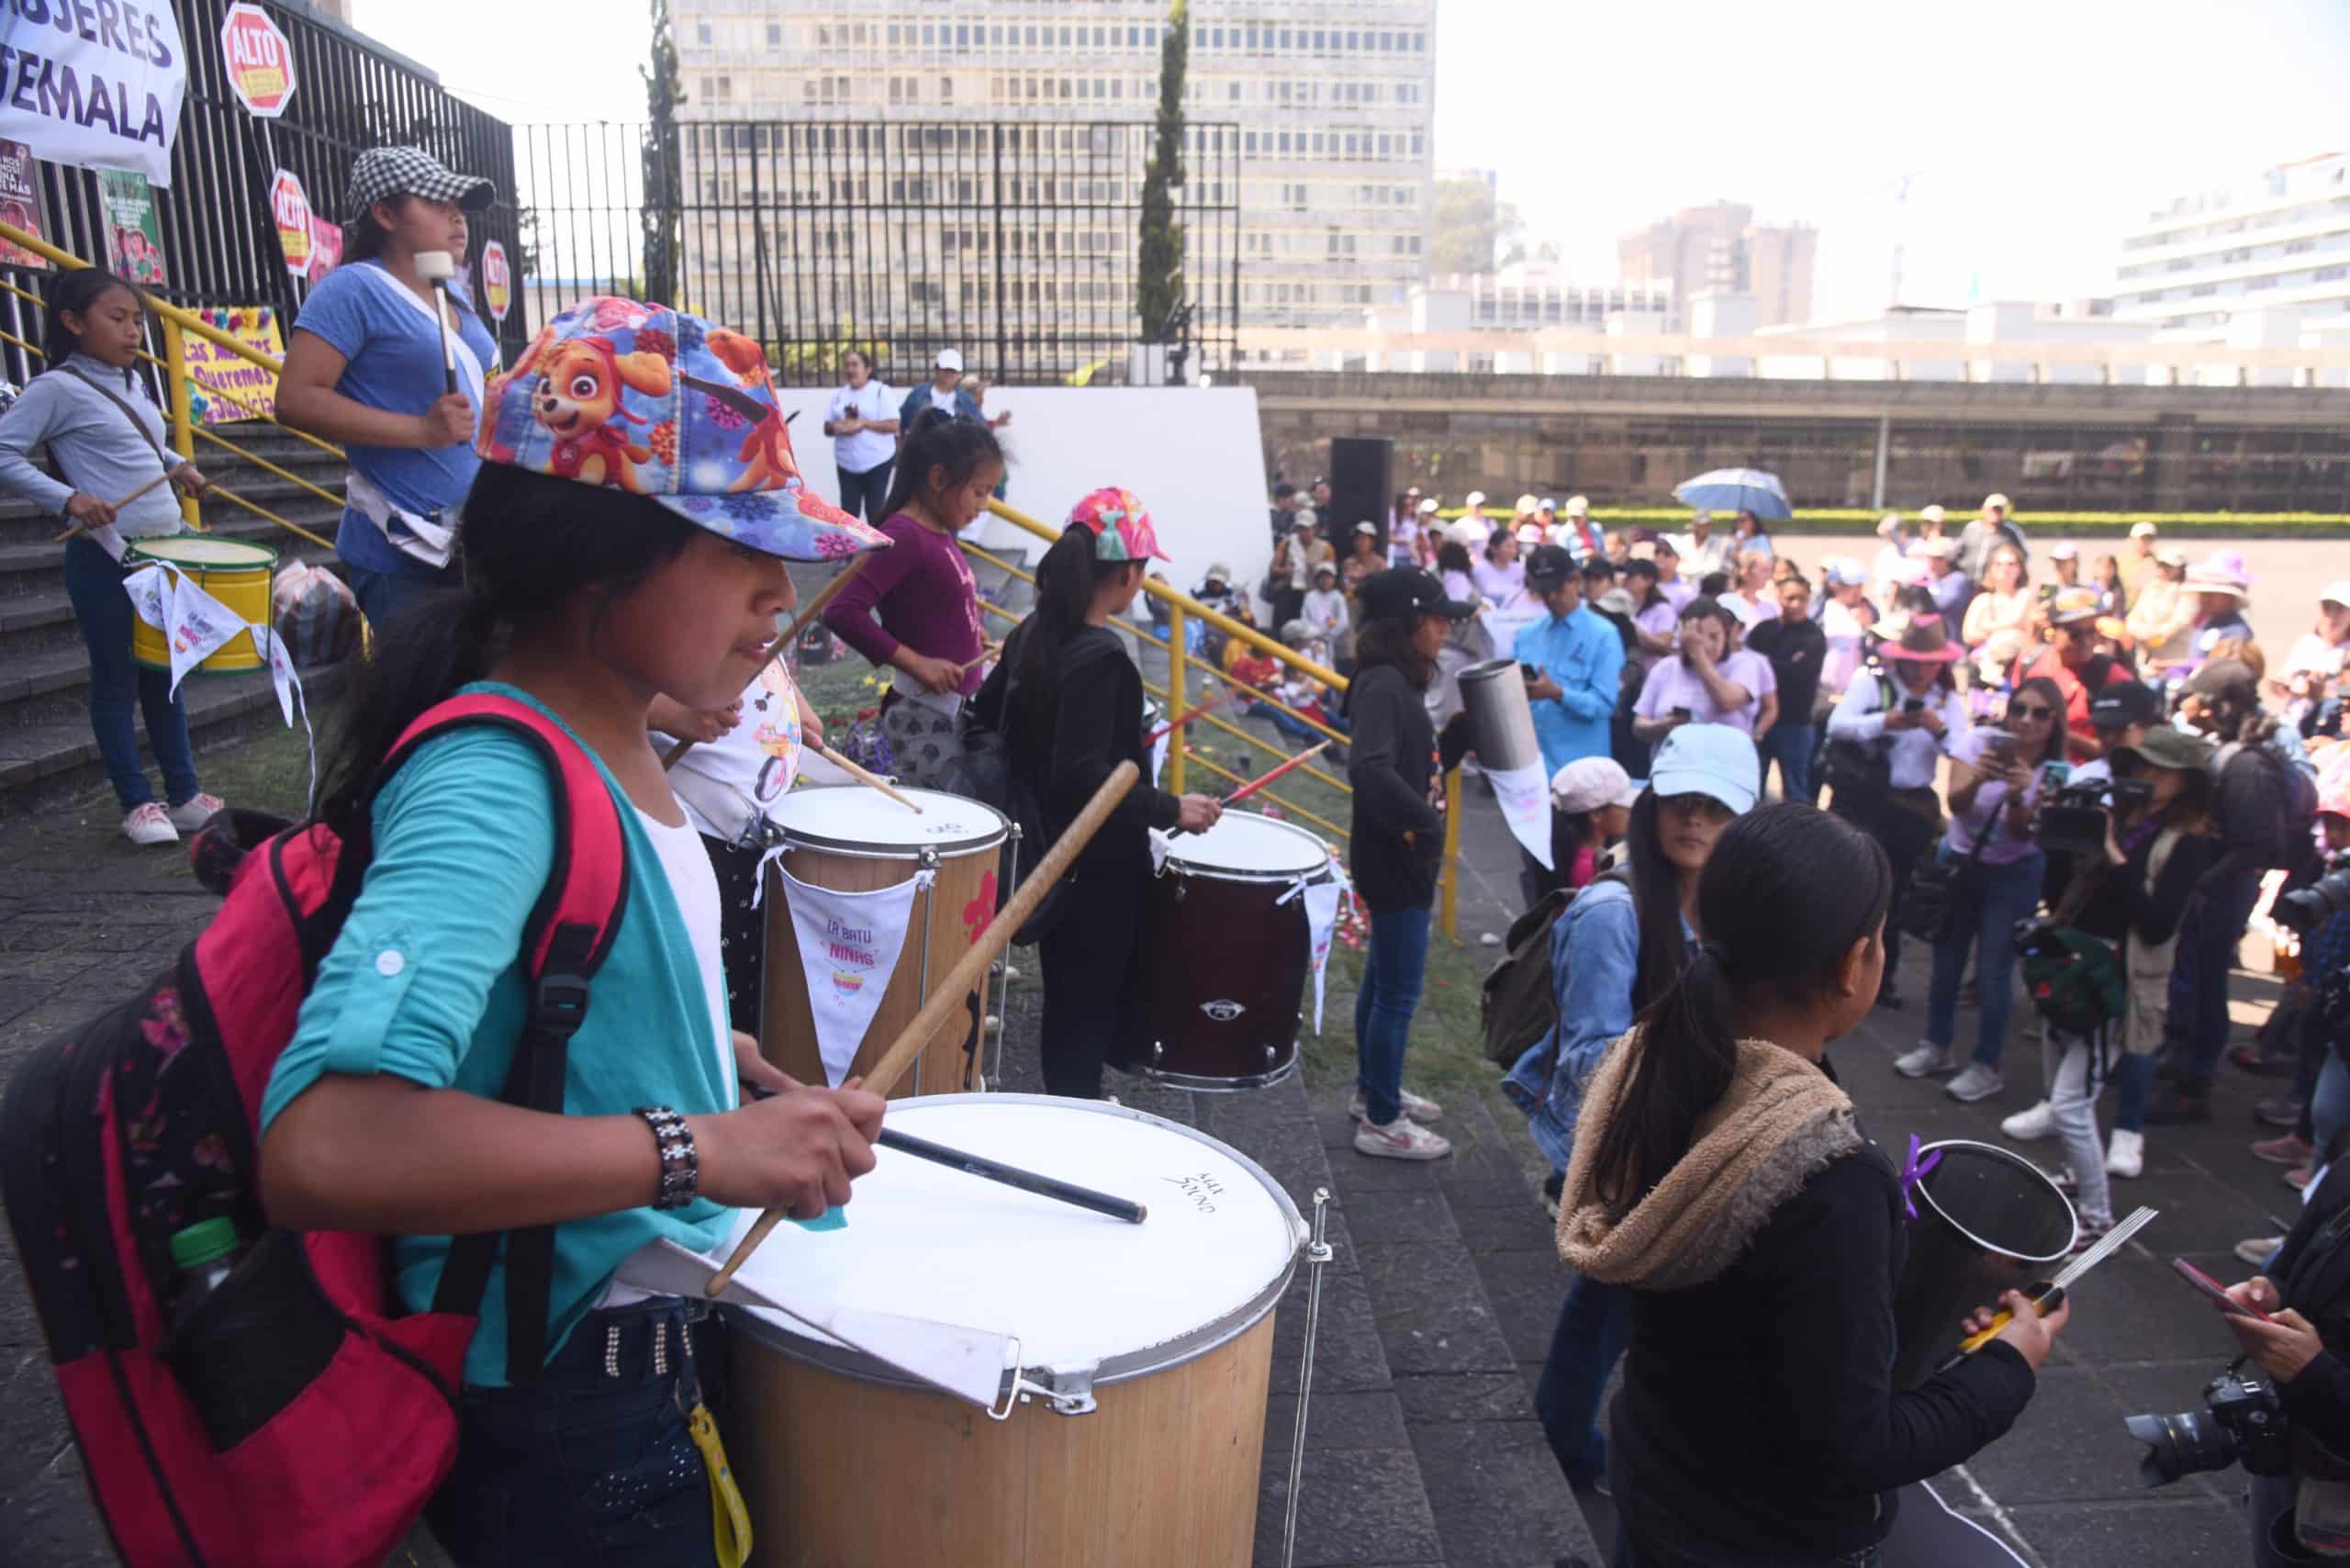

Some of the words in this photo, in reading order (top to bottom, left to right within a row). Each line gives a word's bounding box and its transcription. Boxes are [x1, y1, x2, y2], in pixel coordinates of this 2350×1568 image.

[232, 26, 279, 66] ALTO
[277, 190, 307, 231] ALTO
[194, 365, 274, 392] Queremos
[828, 918, 839, 935] LA
[843, 927, 872, 943] BATU
[1160, 1176, 1216, 1214] SOUND
